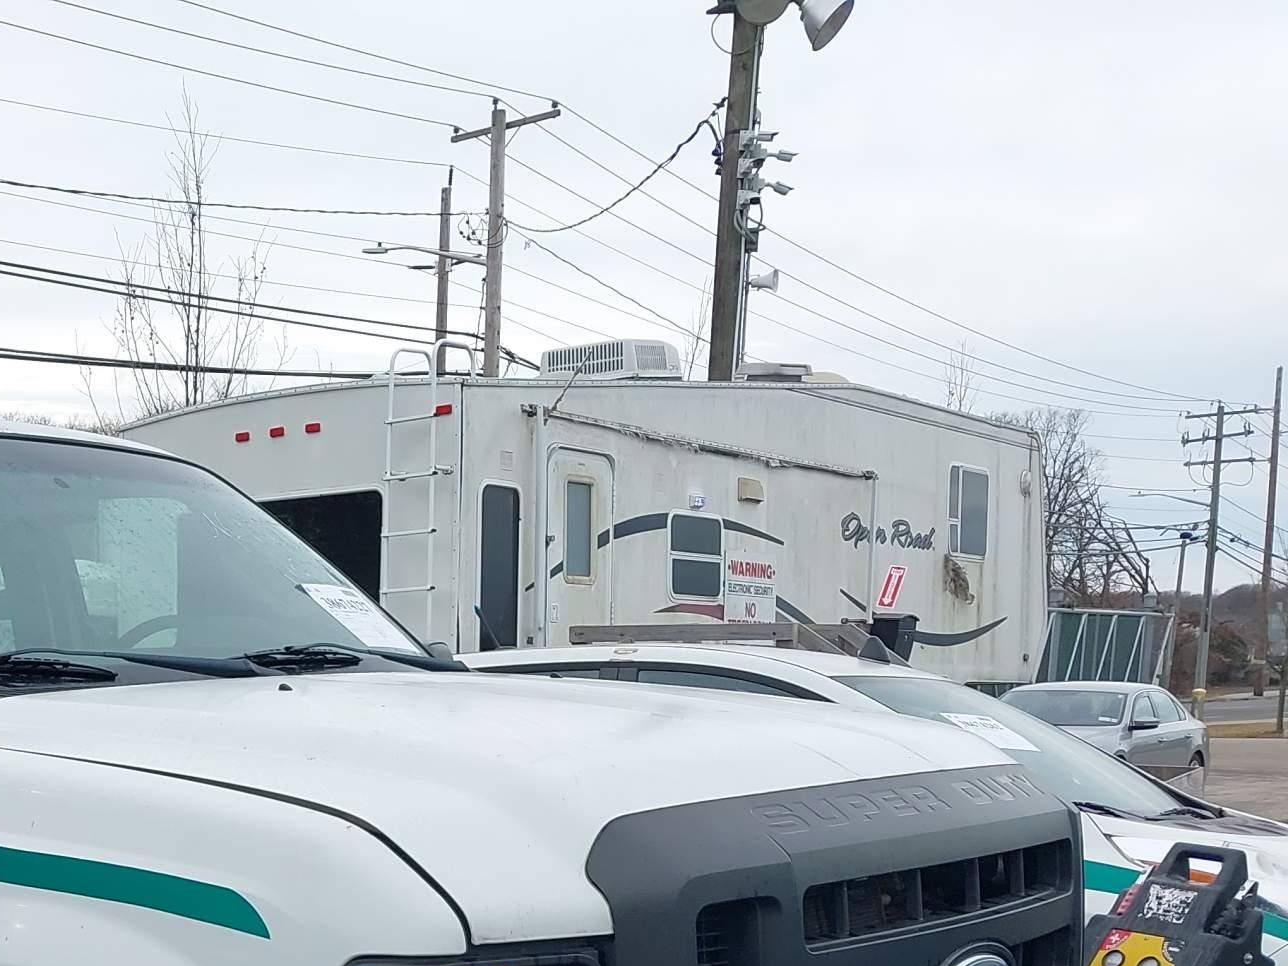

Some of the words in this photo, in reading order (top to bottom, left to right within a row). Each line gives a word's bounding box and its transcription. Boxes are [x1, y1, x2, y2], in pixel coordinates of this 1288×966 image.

[730, 559, 773, 580] WARNING
[745, 602, 757, 618] NO
[751, 784, 952, 835] SUPER
[953, 774, 1046, 805] DUTY
